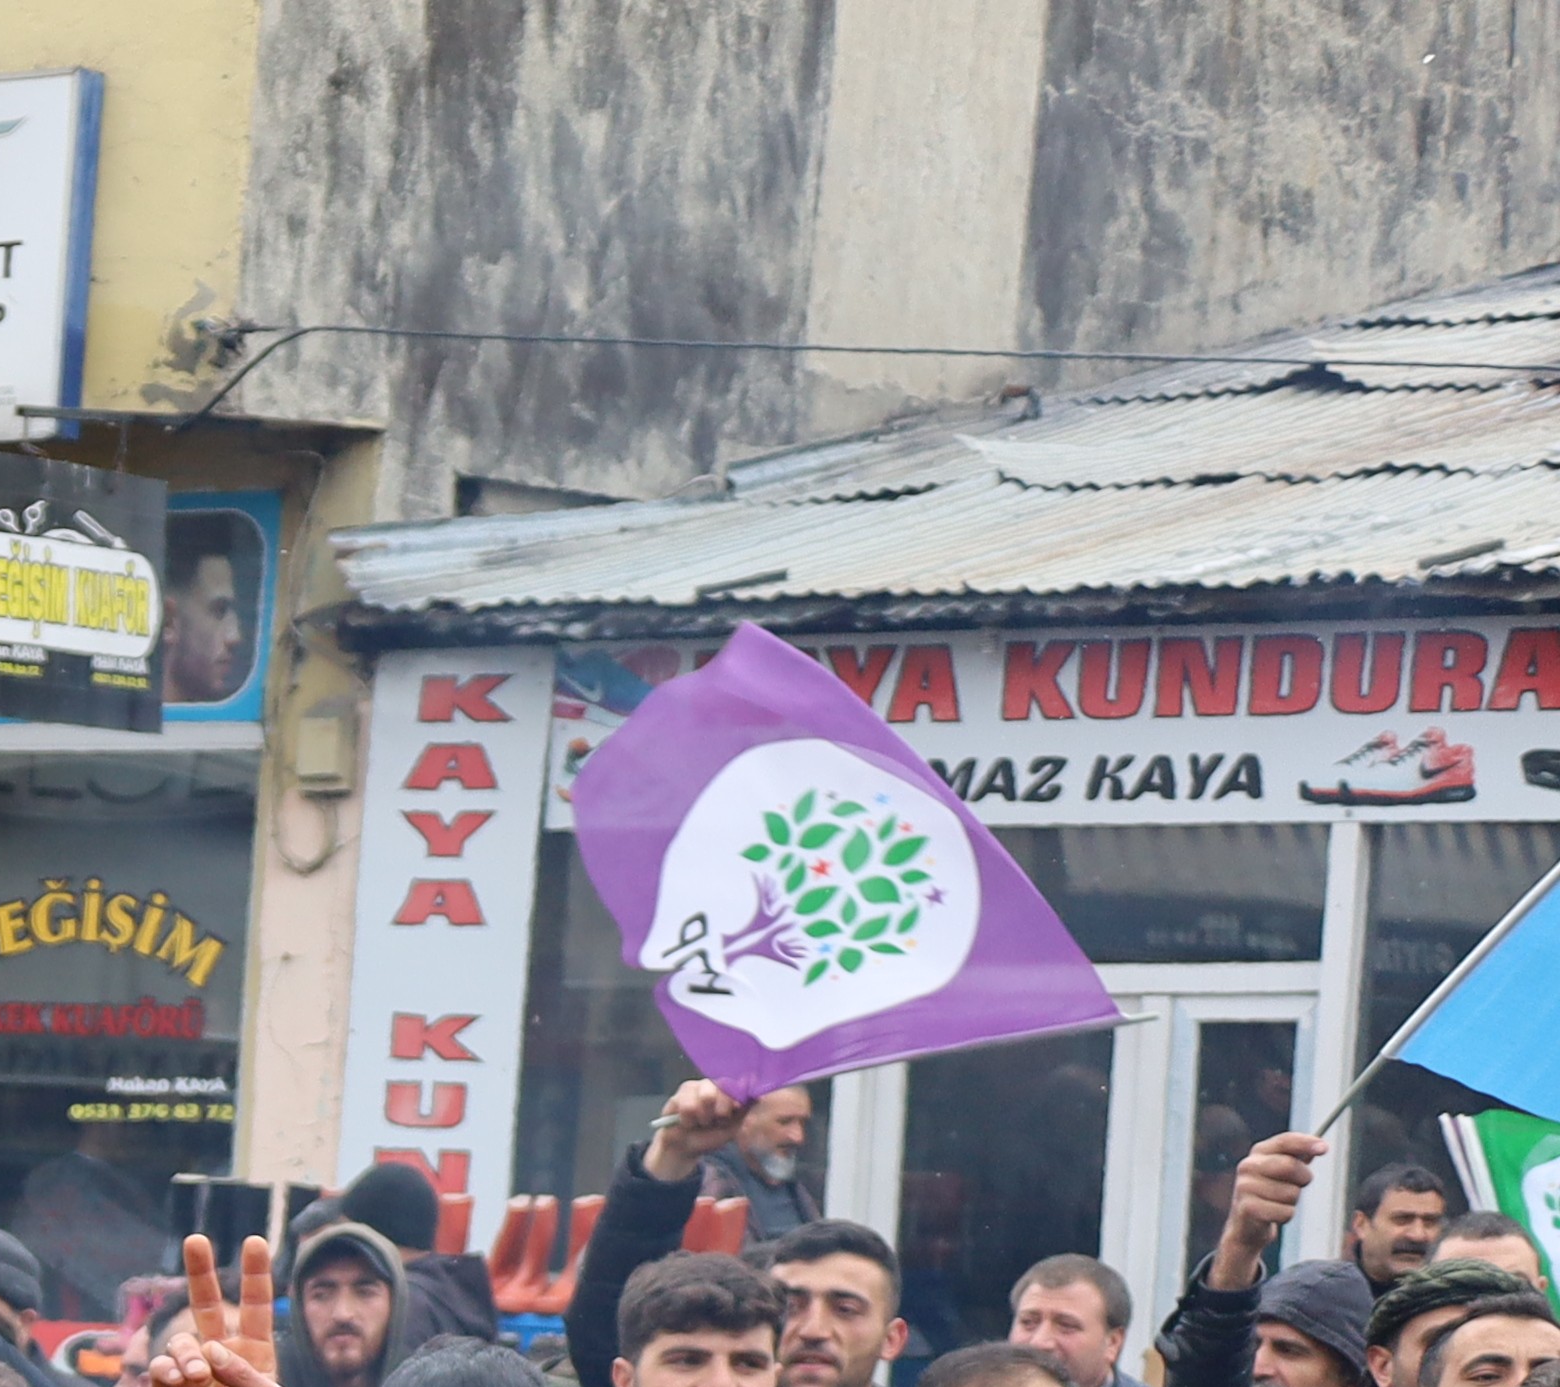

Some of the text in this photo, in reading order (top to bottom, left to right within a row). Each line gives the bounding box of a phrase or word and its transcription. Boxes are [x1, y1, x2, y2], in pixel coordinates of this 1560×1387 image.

[74, 560, 151, 637] KUAFÖR
[1001, 626, 1560, 722] KUNDURA
[391, 673, 515, 925] KAYA
[1085, 753, 1264, 802] KAYA
[48, 995, 206, 1040] KUAFÖRÜ
